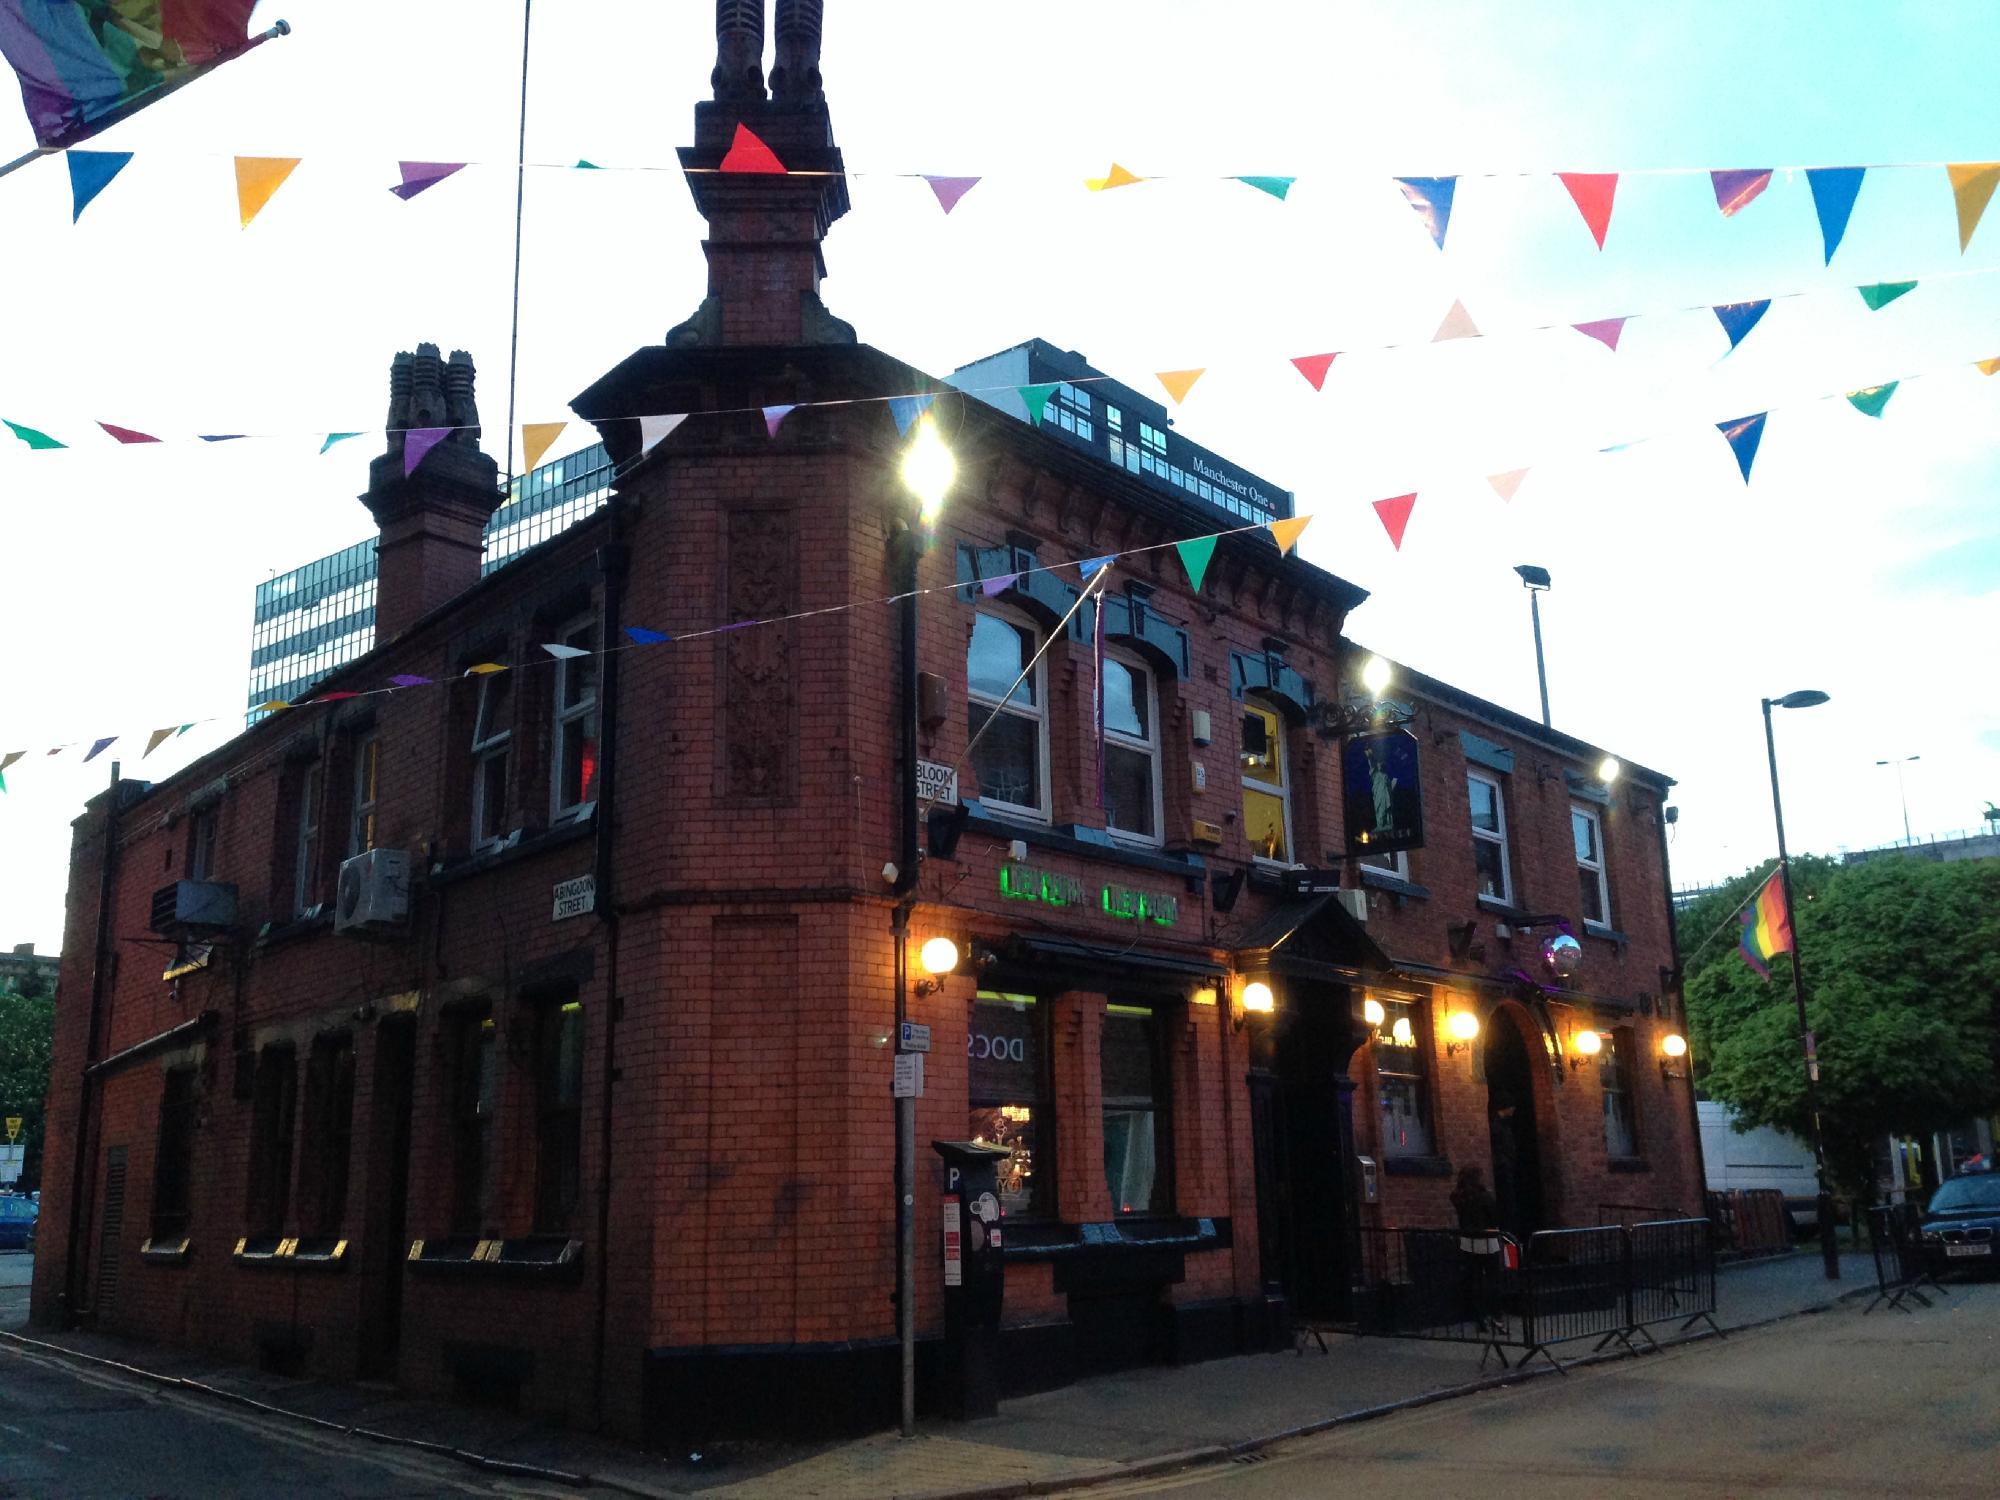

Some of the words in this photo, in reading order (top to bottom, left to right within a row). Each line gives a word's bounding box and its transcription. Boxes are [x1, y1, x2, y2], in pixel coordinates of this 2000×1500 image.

[1193, 456, 1247, 496] Manchester
[1249, 486, 1269, 507] One
[916, 764, 953, 785] BLOOM
[554, 878, 595, 901] ABINGDON
[558, 895, 586, 916] STREET
[904, 1026, 910, 1039] P
[950, 1167, 960, 1190] P
